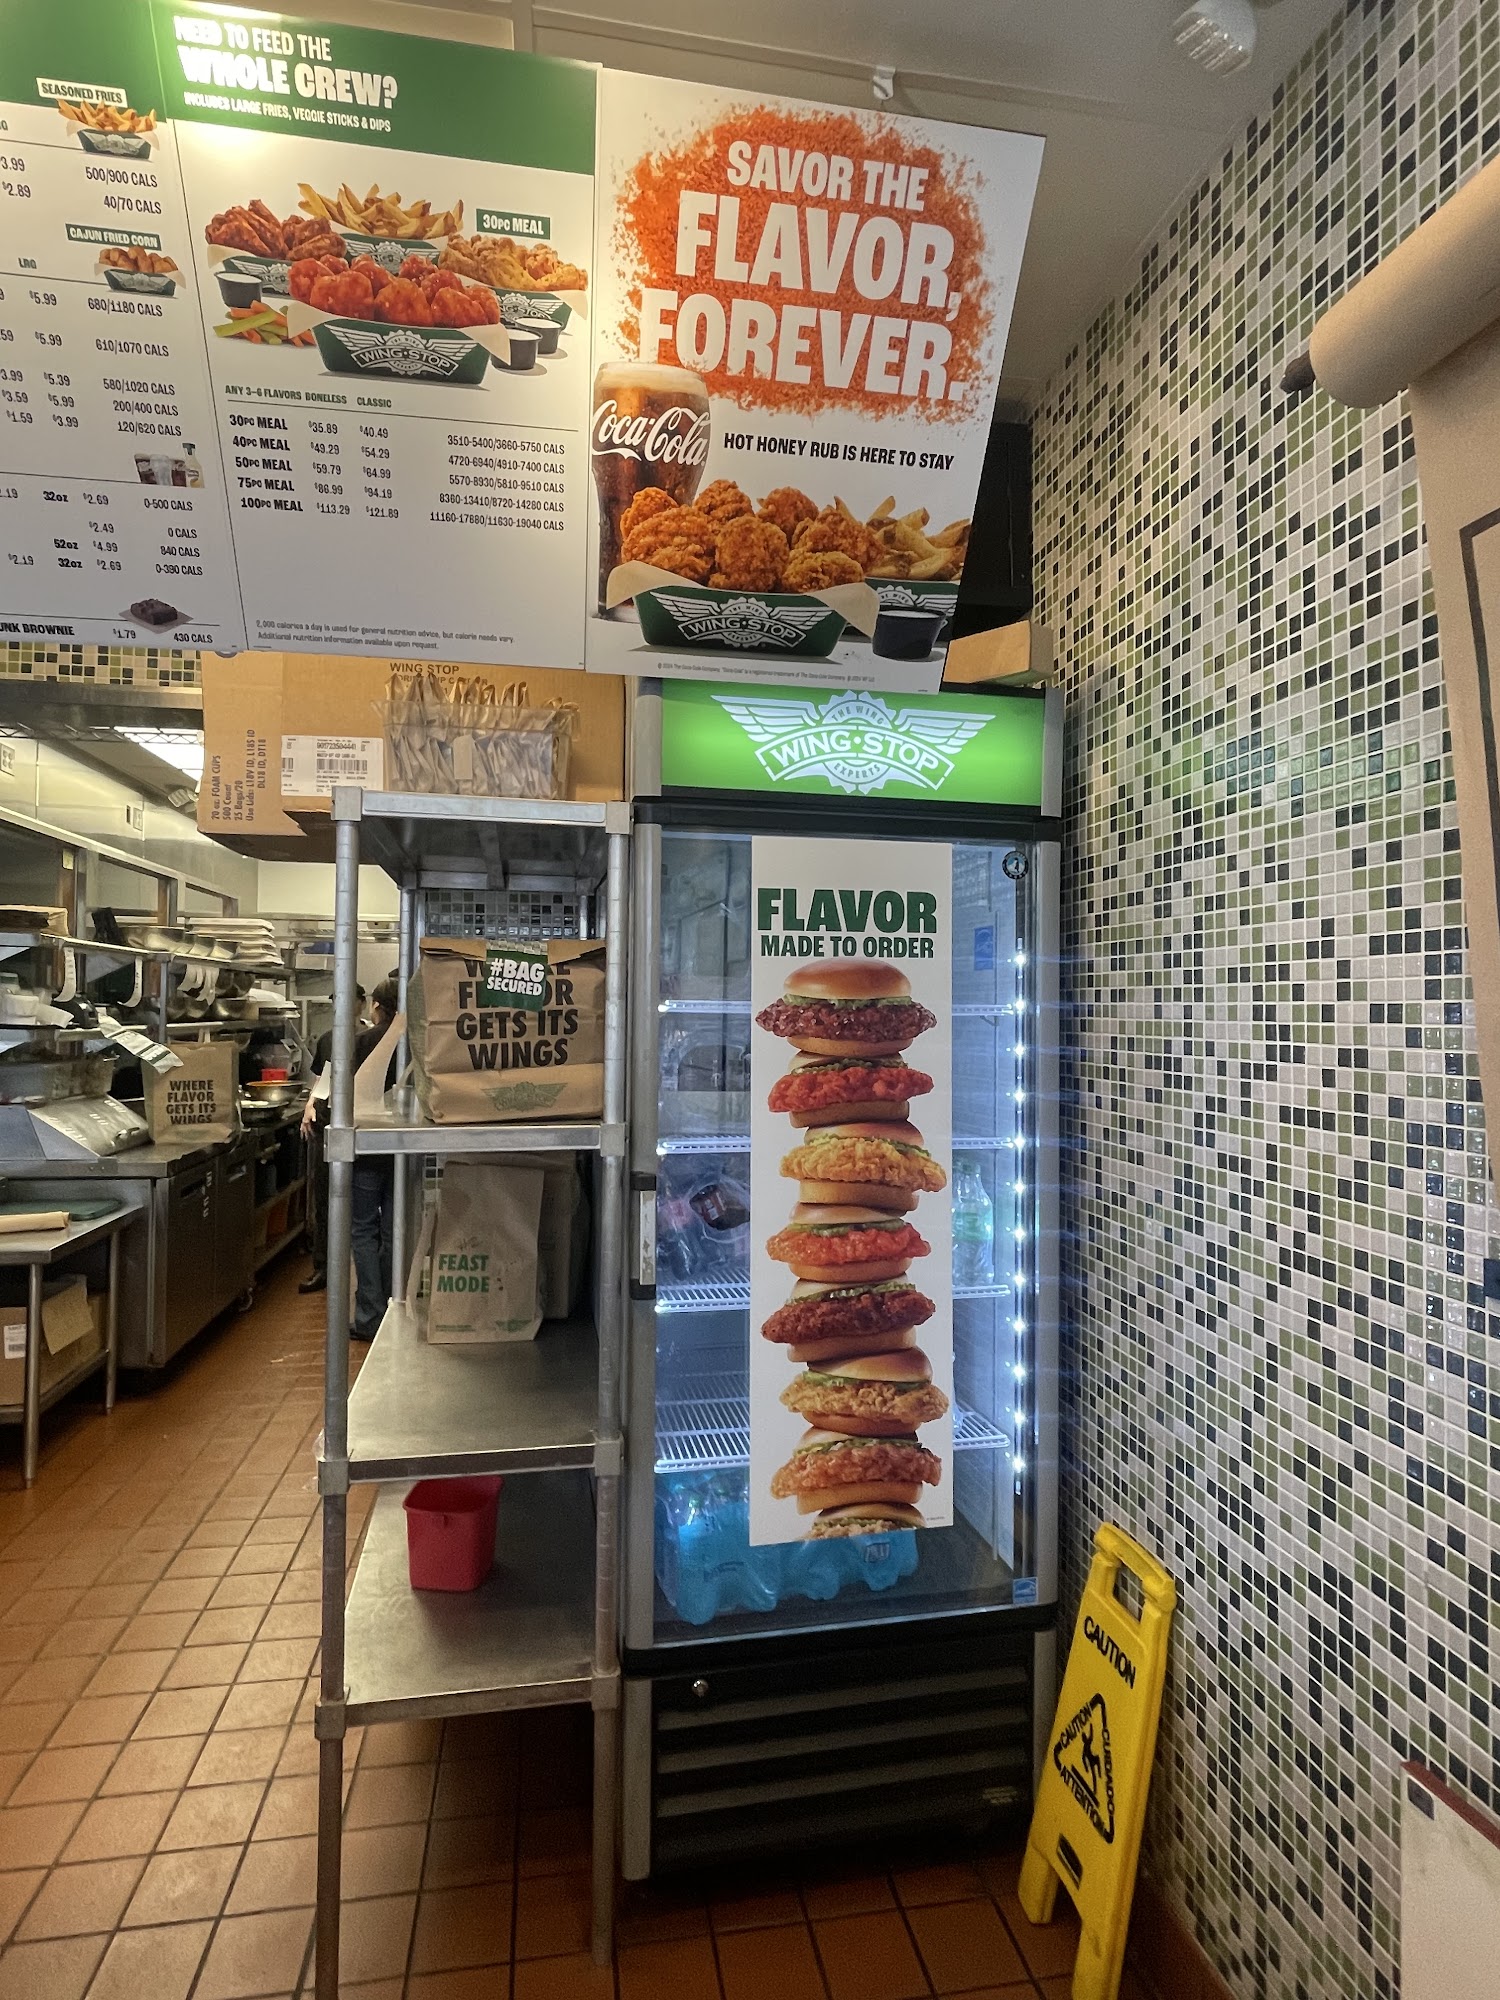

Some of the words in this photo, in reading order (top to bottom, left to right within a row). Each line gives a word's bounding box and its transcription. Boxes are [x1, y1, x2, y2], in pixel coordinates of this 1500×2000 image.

[173, 15, 223, 47] NEED
[223, 21, 250, 50] TO
[251, 26, 295, 56] FEED
[296, 33, 333, 62] THE
[176, 44, 291, 95] WHOLE
[294, 62, 398, 110] CREW?
[41, 82, 94, 100] SEASONED
[95, 89, 123, 104] FRIES
[183, 91, 231, 112] INCLUDES
[230, 97, 262, 116] LARGE
[262, 102, 292, 121] FRIES,
[292, 106, 326, 124] VEGGIE
[326, 111, 360, 129] STICKS
[360, 116, 369, 130] &
[369, 117, 392, 133] DIPS
[85, 166, 129, 185] 500/900
[131, 172, 158, 188] CALS
[726, 140, 855, 201] SAVOR
[860, 158, 930, 212] THE
[2, 181, 31, 198] $2.89
[103, 195, 133, 213] 40/70
[136, 199, 162, 215] CALS
[512, 216, 545, 236] MEAL
[69, 227, 103, 242] CAJUN
[103, 231, 130, 245] FRIED
[131, 234, 158, 248] CORN
[675, 189, 962, 322] FLAVOR,
[29, 290, 57, 306] $5.99
[87, 297, 136, 315] 680/1180
[137, 303, 163, 317] CALS
[35, 331, 62, 347] $5.99
[95, 338, 142, 355] 610/1070
[144, 343, 170, 357] CALS
[639, 287, 966, 402] FOREVER.
[103, 377, 149, 394] 580/1020
[151, 382, 176, 396] CALS
[225, 384, 244, 396] ANY
[263, 388, 302, 400] FLAVORS
[305, 391, 348, 405] BONELESS
[356, 396, 392, 408] CLASSIC
[112, 400, 153, 415] 200/400
[154, 403, 179, 417] CALS
[117, 420, 156, 436] 120/620
[157, 423, 182, 437] CALS
[257, 416, 288, 430] MEAL
[308, 420, 338, 435] $35.89
[359, 425, 389, 439] $40.49
[543, 443, 565, 455] CALS
[592, 399, 711, 467] Coca-Cola
[259, 437, 291, 451] MEAL
[310, 441, 340, 455] $49.29
[361, 445, 390, 459] $54.29
[543, 462, 565, 474] CALS
[724, 432, 754, 451] HOT
[756, 435, 809, 456] HONEY
[810, 441, 839, 460] RUB
[842, 444, 857, 462] IS
[859, 446, 896, 465] HERE
[899, 450, 916, 467] TO
[919, 452, 955, 471] STAY
[262, 458, 293, 472] MEAL
[312, 462, 342, 476] $59.79
[543, 482, 565, 493] CALS
[42, 490, 69, 503] 32oz
[143, 498, 169, 510] 0-500
[170, 499, 193, 511] CALS
[264, 478, 295, 492] MEAL
[543, 501, 565, 512] CALS
[273, 499, 304, 512] MEAL
[543, 520, 564, 531] CALS
[167, 527, 173, 538] 0
[174, 527, 198, 539] CALS
[53, 538, 79, 550] 52oz
[178, 546, 200, 558] CALS
[57, 557, 83, 569] 32oz
[181, 564, 203, 576] CALS
[22, 623, 75, 636] BROWNIE
[173, 632, 190, 643] 430
[191, 633, 213, 644] CALS
[258, 631, 291, 641] Additional
[293, 634, 322, 642] nutrition
[324, 636, 363, 644] information
[276, 622, 304, 630] calories
[310, 623, 322, 632] day
[332, 624, 347, 632] used
[361, 626, 386, 635] general
[387, 629, 417, 637] nutrition
[389, 662, 423, 673] WING
[427, 664, 460, 675] STOP
[830, 704, 852, 723] THE
[854, 704, 886, 726] WING
[212, 755, 221, 774] CUPS
[833, 762, 882, 780] EXPERTS
[211, 775, 220, 797] FOAM
[223, 784, 232, 805] Count
[222, 806, 231, 821] 500
[757, 887, 937, 934] FLAVOR
[760, 934, 825, 957] MADE
[830, 935, 858, 957] TO
[863, 936, 935, 959] ORDER
[489, 957, 545, 983] #BAG
[486, 976, 543, 997] SECURED
[455, 1010, 528, 1041] GETS
[537, 1008, 579, 1037] ITS
[467, 1038, 569, 1071] WINGS
[169, 1079, 214, 1092] WHERE
[167, 1091, 215, 1103] FLAVOR
[165, 1103, 195, 1115] GETS
[198, 1102, 217, 1114] ITS
[169, 1114, 213, 1125] WINGS
[438, 1253, 489, 1272] FEAST
[436, 1274, 490, 1293] MODE
[1083, 1615, 1137, 1690] CAUTION
[1059, 1701, 1093, 1749] CAUTION
[1101, 1727, 1116, 1817] CUIDADO
